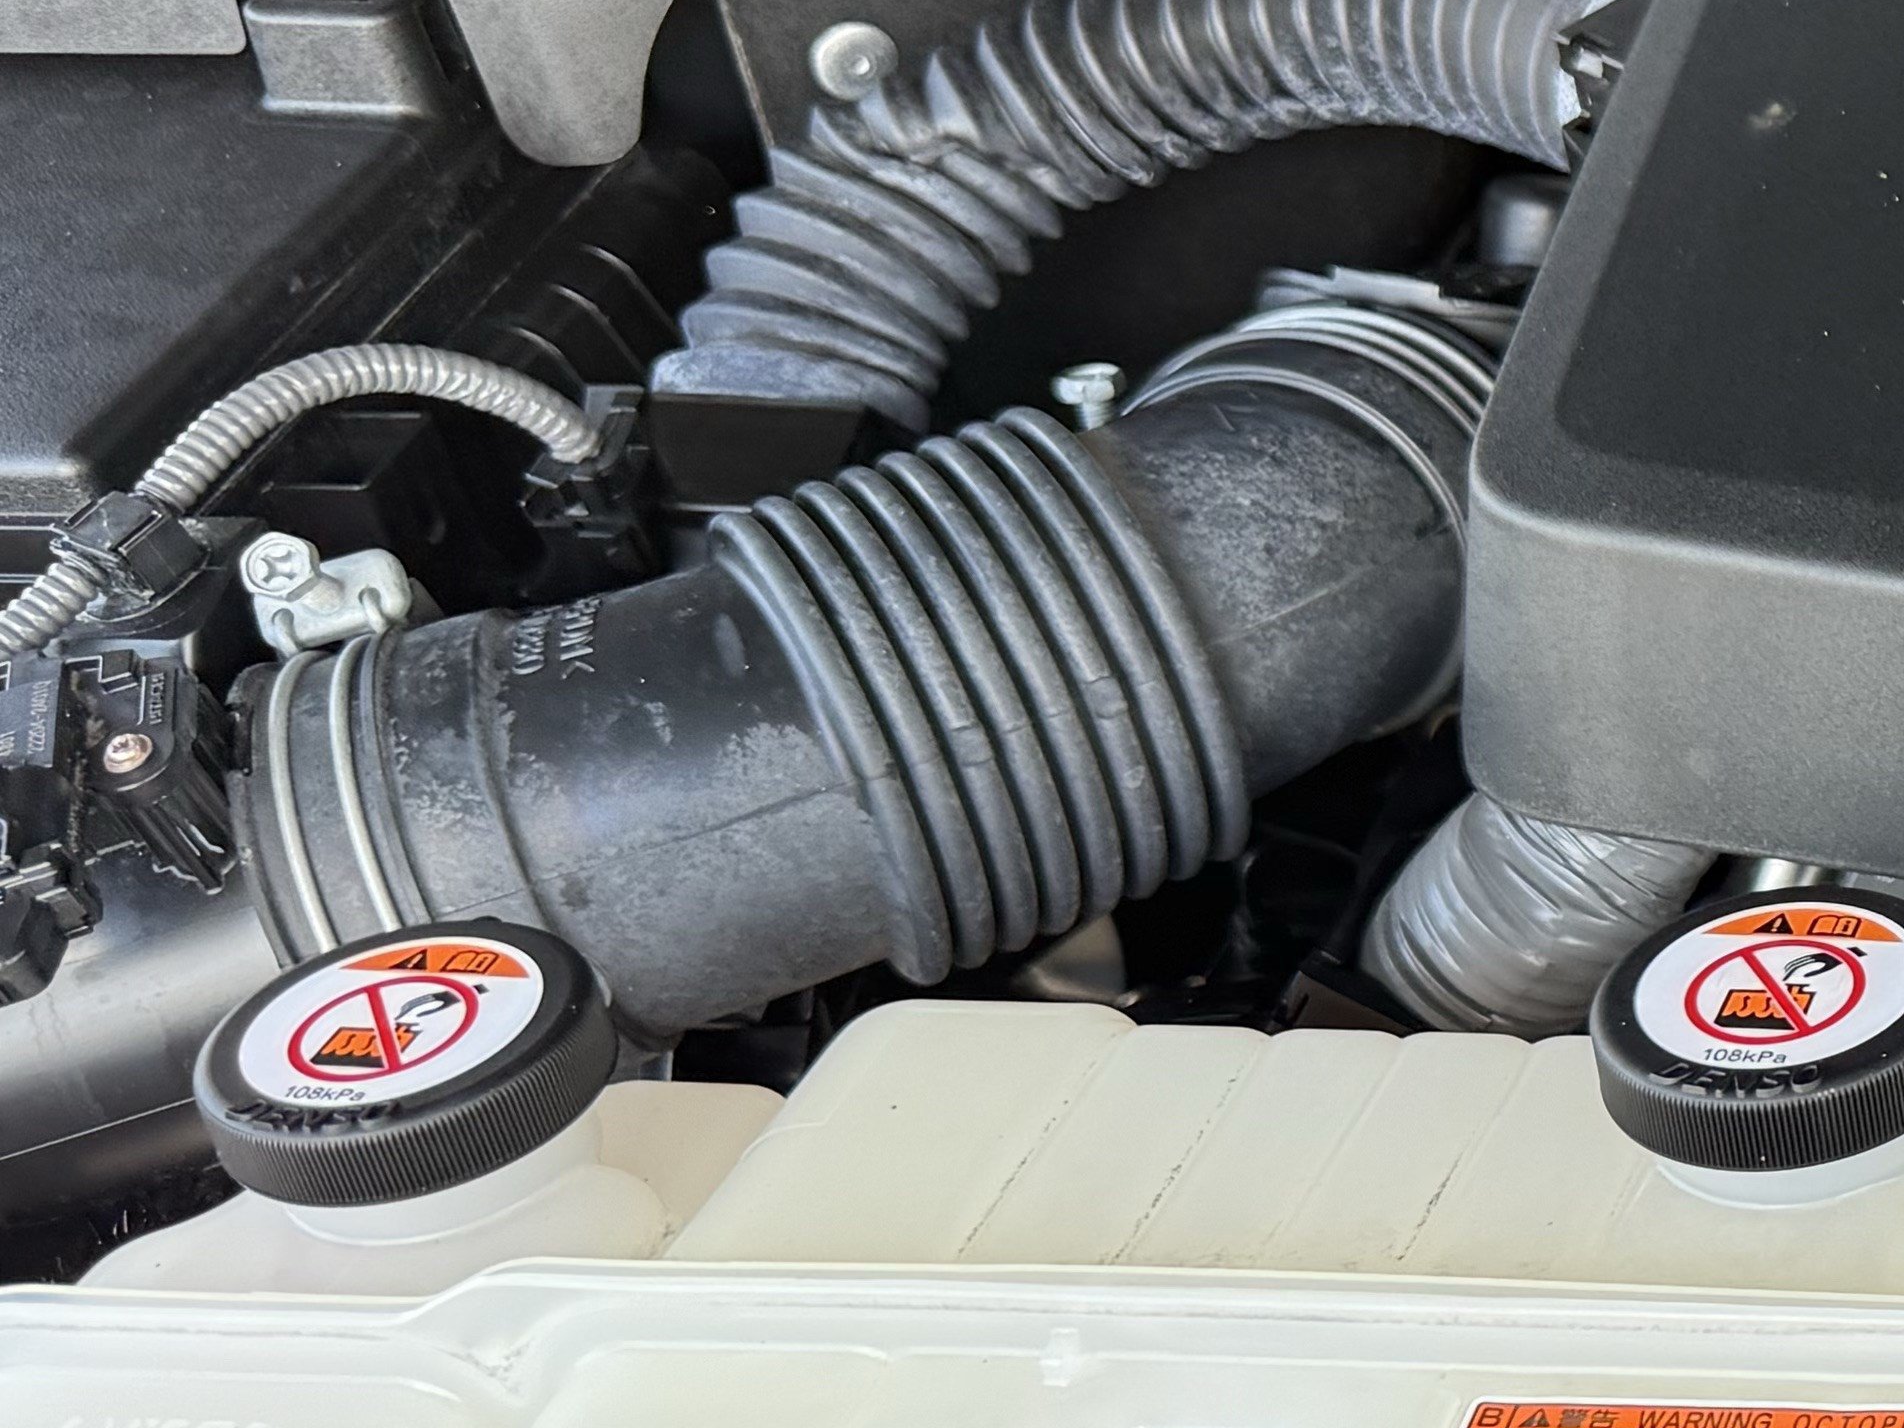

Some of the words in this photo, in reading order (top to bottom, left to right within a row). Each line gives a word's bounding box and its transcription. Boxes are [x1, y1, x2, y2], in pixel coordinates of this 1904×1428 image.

[1703, 1048, 1787, 1064] 108kPa
[285, 1085, 366, 1102] 108kPa
[1476, 1407, 1505, 1426] B
